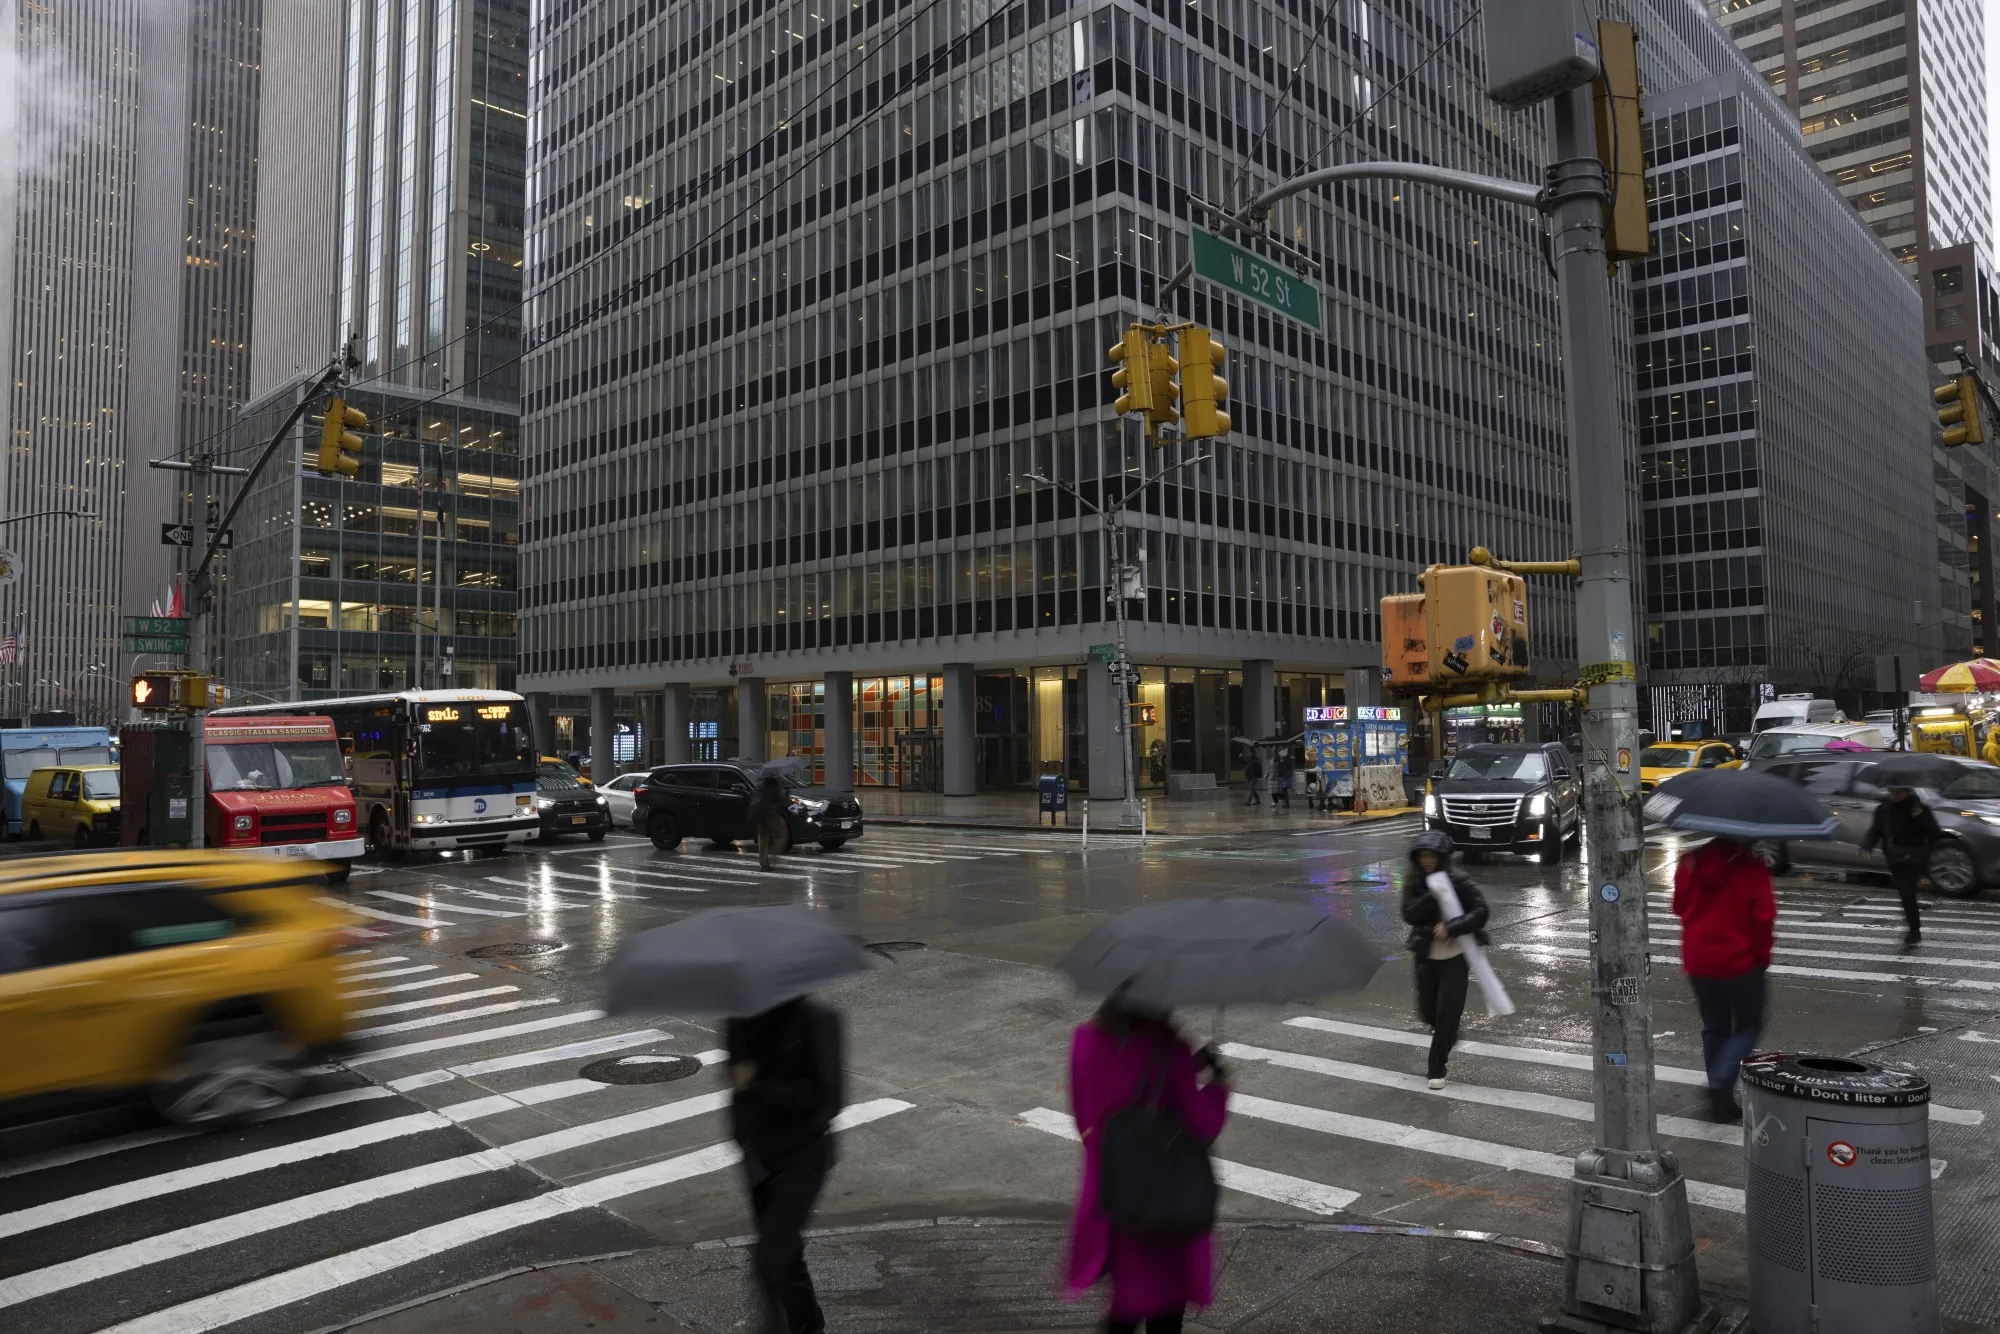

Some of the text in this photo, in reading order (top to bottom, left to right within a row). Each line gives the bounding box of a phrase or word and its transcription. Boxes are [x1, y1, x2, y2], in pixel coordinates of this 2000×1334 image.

[1230, 252, 1292, 308] W 52 St
[172, 530, 192, 540] ONE
[139, 619, 150, 633] W
[153, 620, 173, 634] 52
[138, 638, 172, 652] SWING
[737, 663, 753, 675] UBS
[976, 695, 993, 712] BS
[244, 728, 277, 736] ITALIAN
[280, 727, 329, 736] SANDWICHES
[1811, 1088, 1887, 1103] Don't litter
[1856, 1147, 1882, 1155] Thank
[1884, 1148, 1898, 1157] you
[1900, 1147, 1909, 1155] for
[1870, 1157, 1895, 1165] clean:
